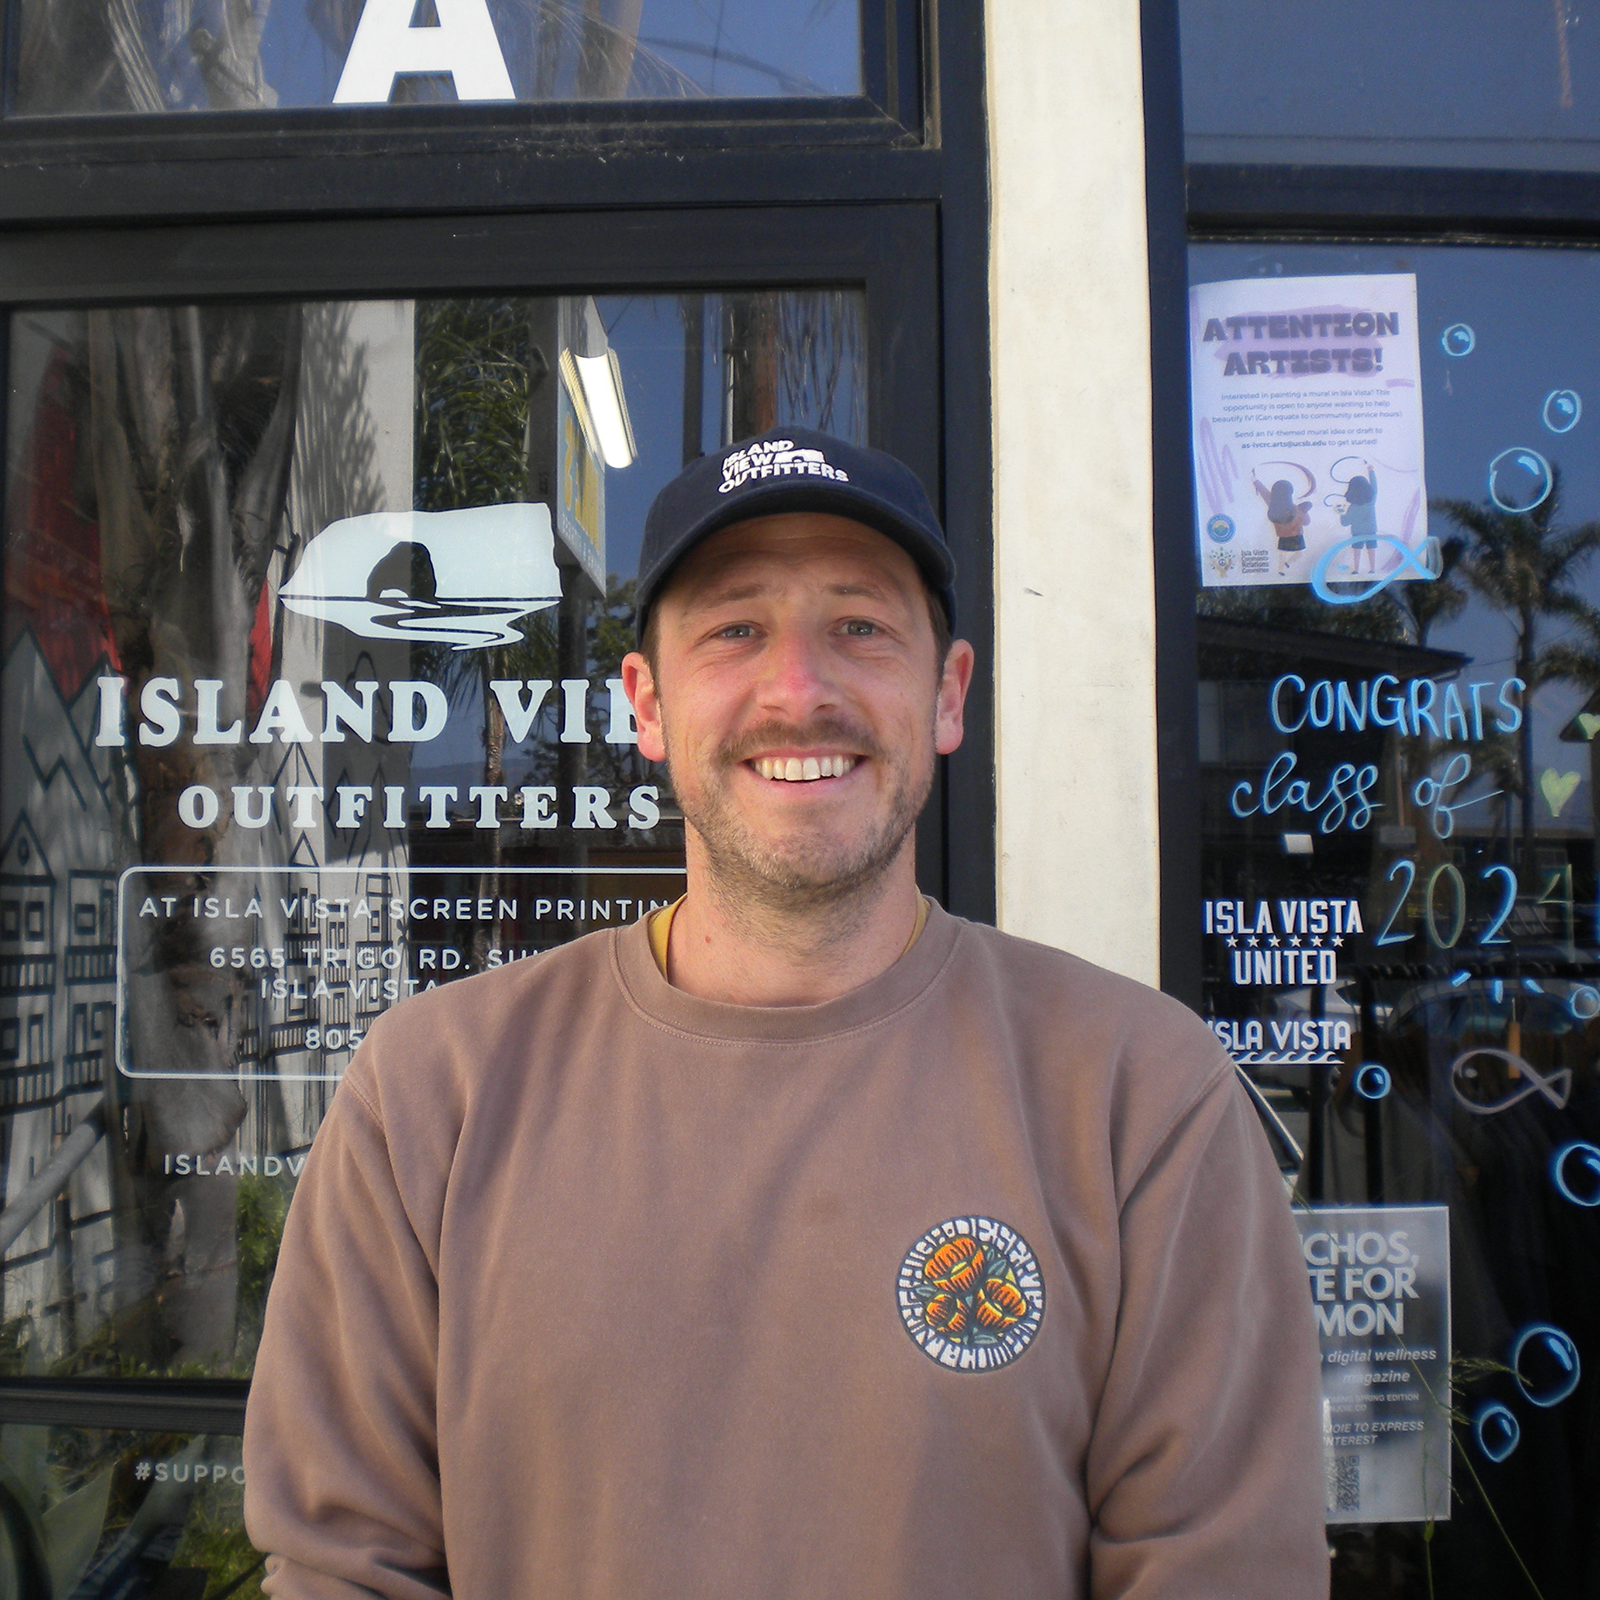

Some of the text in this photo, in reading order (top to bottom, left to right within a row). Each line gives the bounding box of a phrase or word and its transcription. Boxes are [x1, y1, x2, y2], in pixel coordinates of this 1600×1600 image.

[332, 0, 516, 103] A
[1203, 312, 1399, 342] ATTENTION
[1224, 348, 1384, 376] ARTISTS!
[1212, 414, 1243, 423] beautify
[1223, 403, 1267, 412] opportunity
[1234, 430, 1254, 438] Send
[1337, 439, 1350, 447] get
[722, 440, 795, 470] ISLAND
[723, 453, 774, 482] VIEW
[718, 462, 849, 493] OUTFITTERS
[95, 676, 448, 747] ISLAND
[1271, 674, 1526, 741] CONGRATS
[177, 785, 660, 830] OUTFITTERS
[1231, 751, 1504, 840] class of
[139, 898, 177, 918] AT
[193, 898, 263, 918] ISLA
[280, 898, 371, 919] VISTA
[388, 899, 518, 920] SCREEN
[1206, 901, 1364, 934] ISLA VISTA
[209, 947, 285, 969] 6565
[302, 948, 402, 969] TRIGO
[418, 949, 470, 970] RD.
[1234, 951, 1337, 985] UNITED
[261, 979, 332, 1000] ISLA
[304, 1029, 365, 1050] 805
[1271, 1020, 1351, 1050] VISTA
[1299, 1231, 1419, 1271] CHOS,
[1308, 1267, 1421, 1301] E FOR
[1327, 1349, 1371, 1366] digital
[1375, 1349, 1437, 1361] wellness
[1343, 1370, 1410, 1386] magazine
[1387, 1393, 1420, 1402] EDITION
[1354, 1423, 1369, 1432] TO
[1371, 1421, 1425, 1432] EXPRESS
